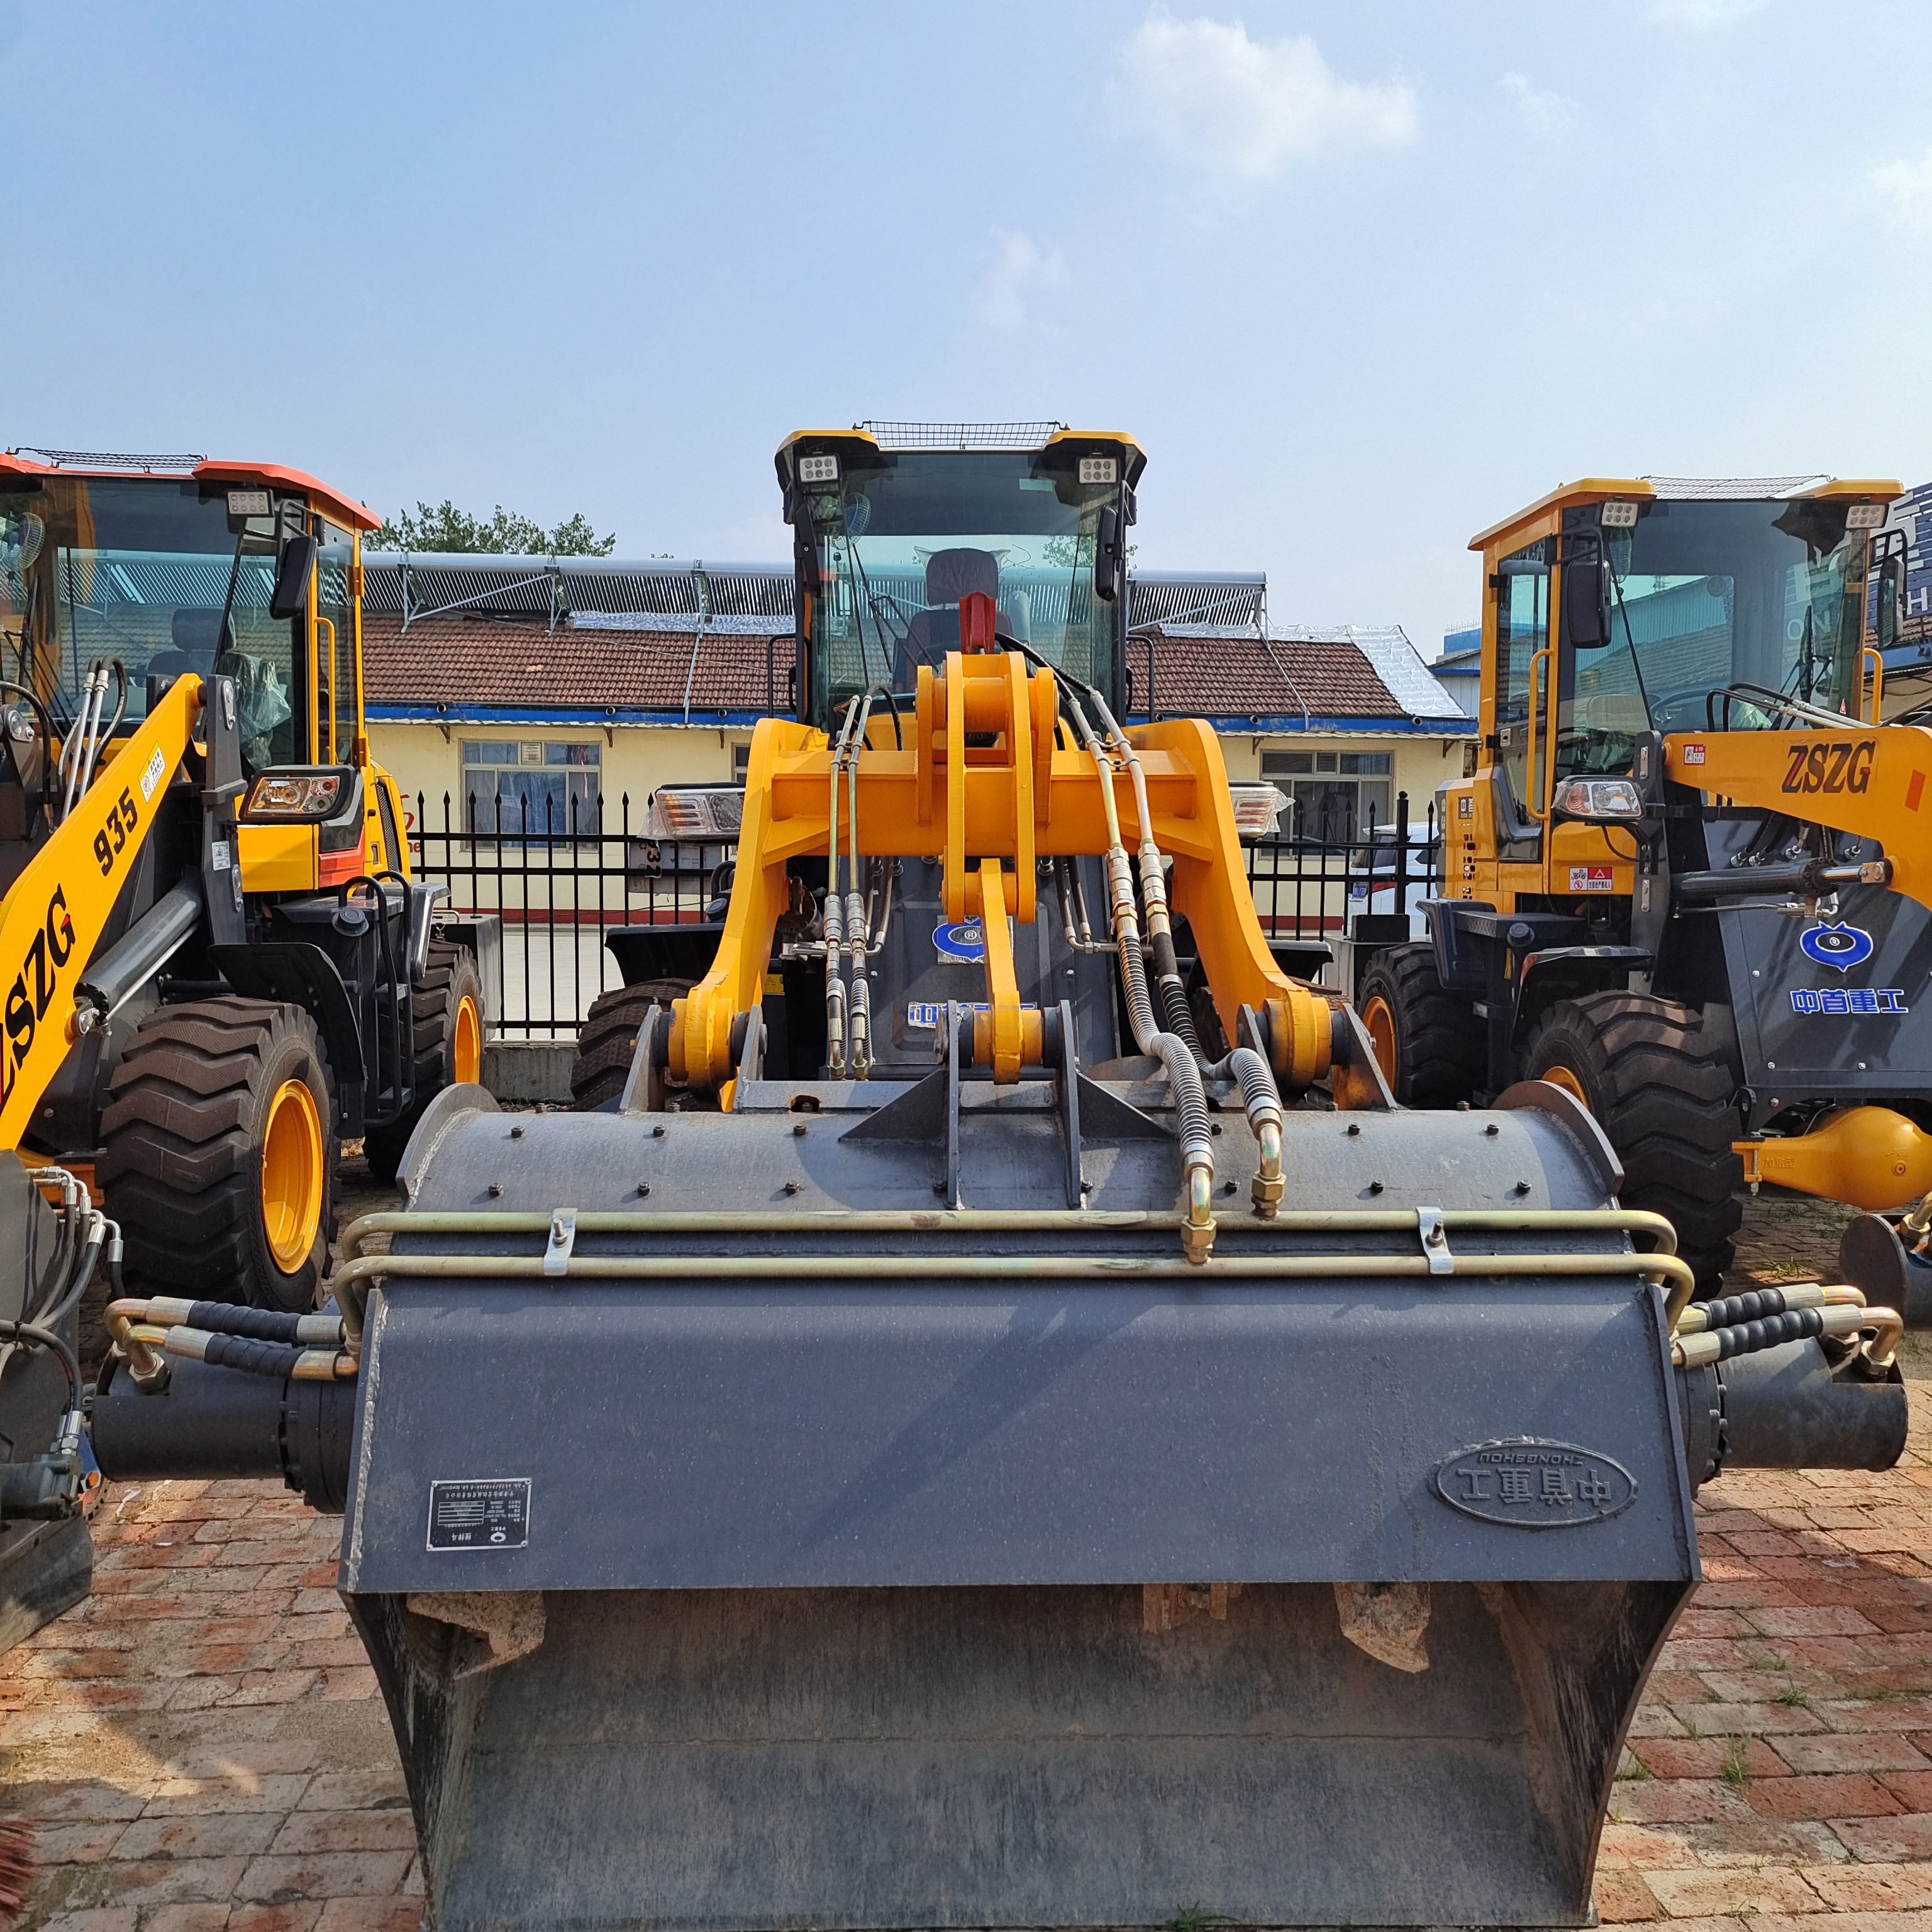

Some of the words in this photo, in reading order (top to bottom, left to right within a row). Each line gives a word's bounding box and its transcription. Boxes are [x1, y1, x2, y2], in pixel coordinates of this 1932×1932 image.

[1782, 741, 1876, 794] ZSZG
[94, 785, 138, 877] 935
[1790, 989, 1909, 1014] 中首重工
